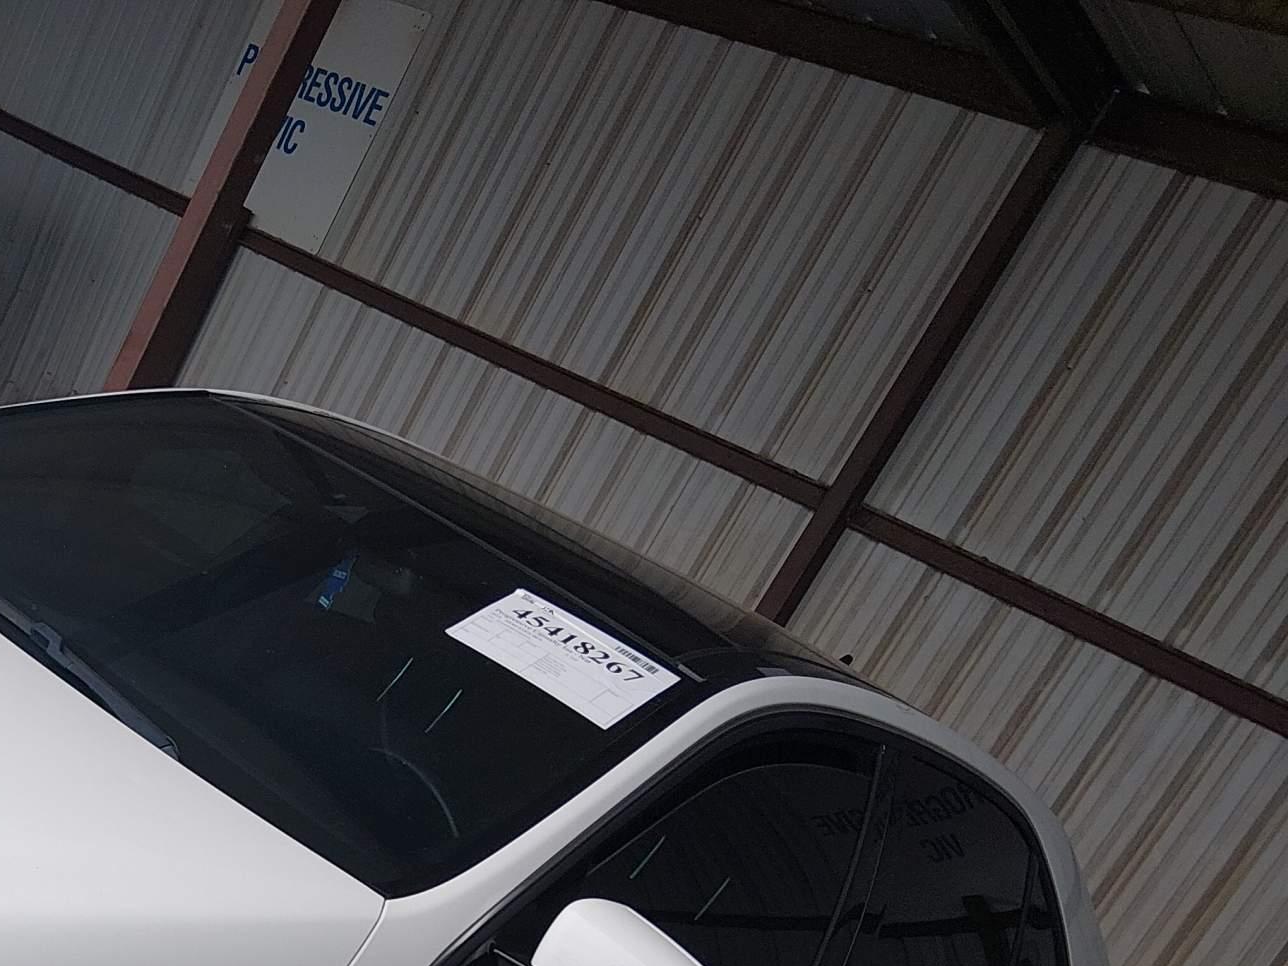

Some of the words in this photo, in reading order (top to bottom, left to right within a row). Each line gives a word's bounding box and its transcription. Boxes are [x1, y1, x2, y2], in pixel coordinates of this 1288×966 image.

[236, 43, 390, 127] PRESSIVE
[276, 114, 306, 154] IC
[512, 609, 645, 681] 45418267
